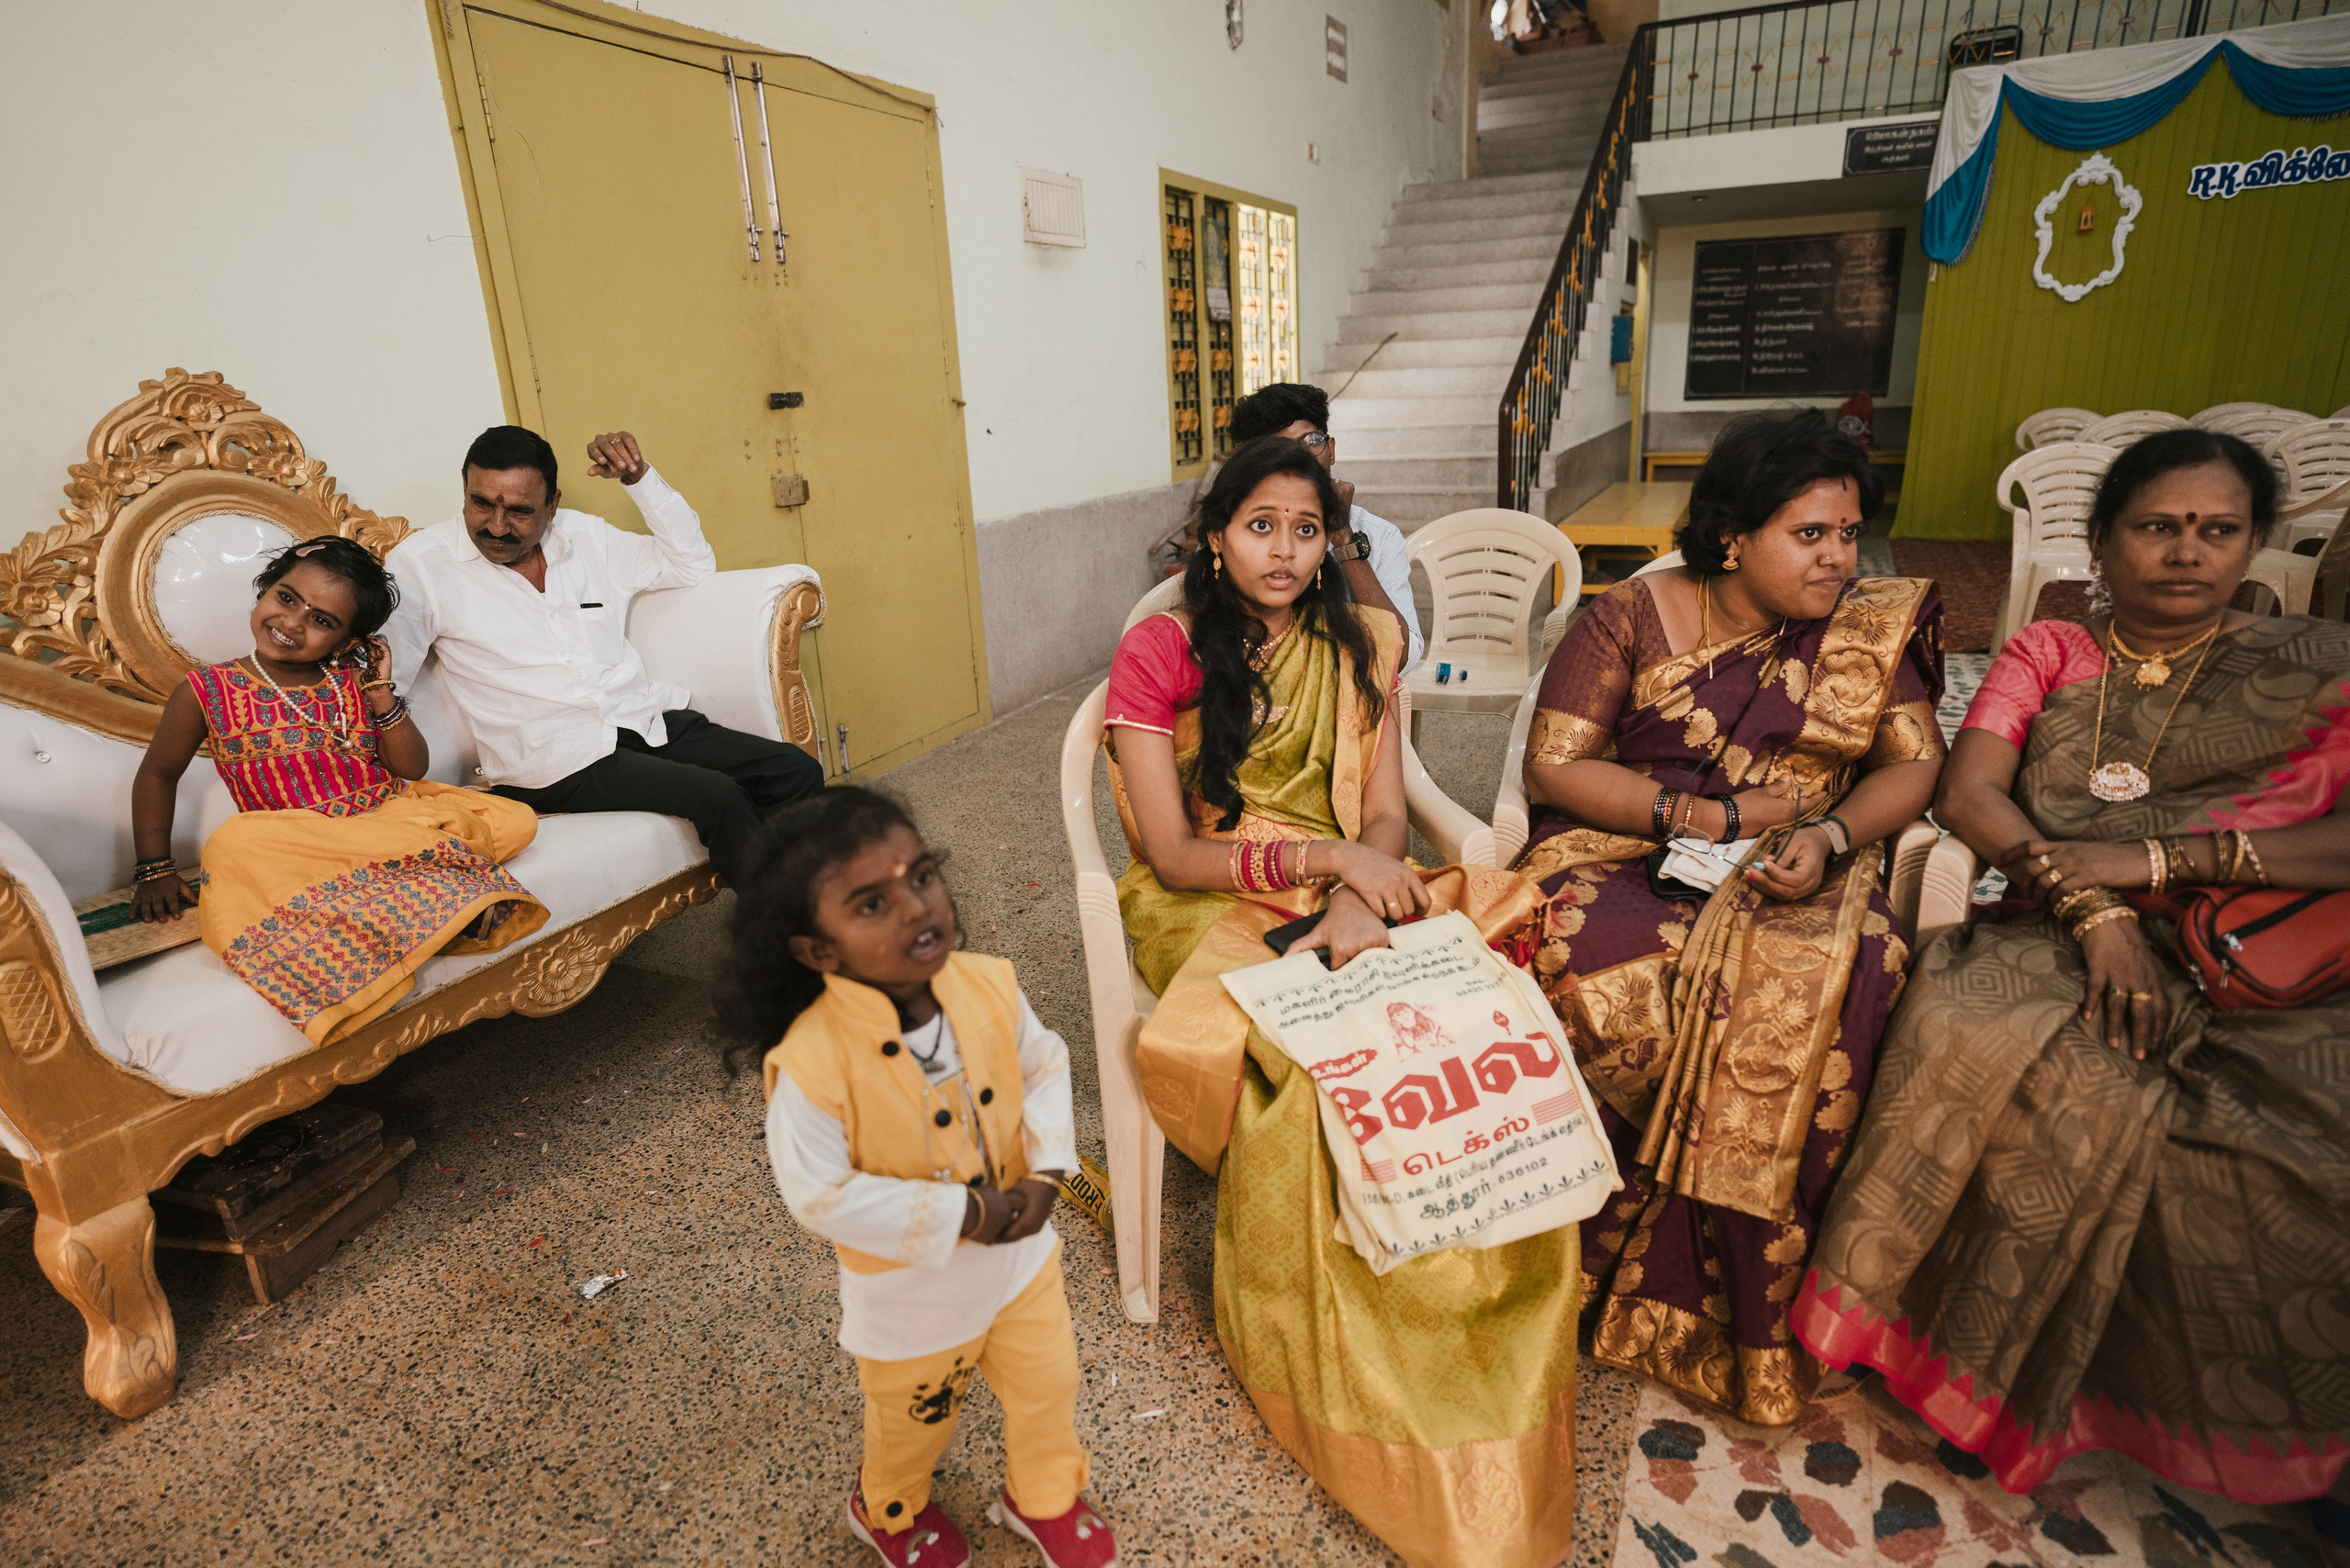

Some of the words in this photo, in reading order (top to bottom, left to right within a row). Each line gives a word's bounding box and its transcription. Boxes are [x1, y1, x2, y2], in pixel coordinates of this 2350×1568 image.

[1403, 1115, 1530, 1176] டெக்ஸ்
[1066, 1172, 1103, 1216] FROO
[1419, 1178, 1492, 1220] ஆத்தூர்
[1498, 1158, 1549, 1184] 636102
